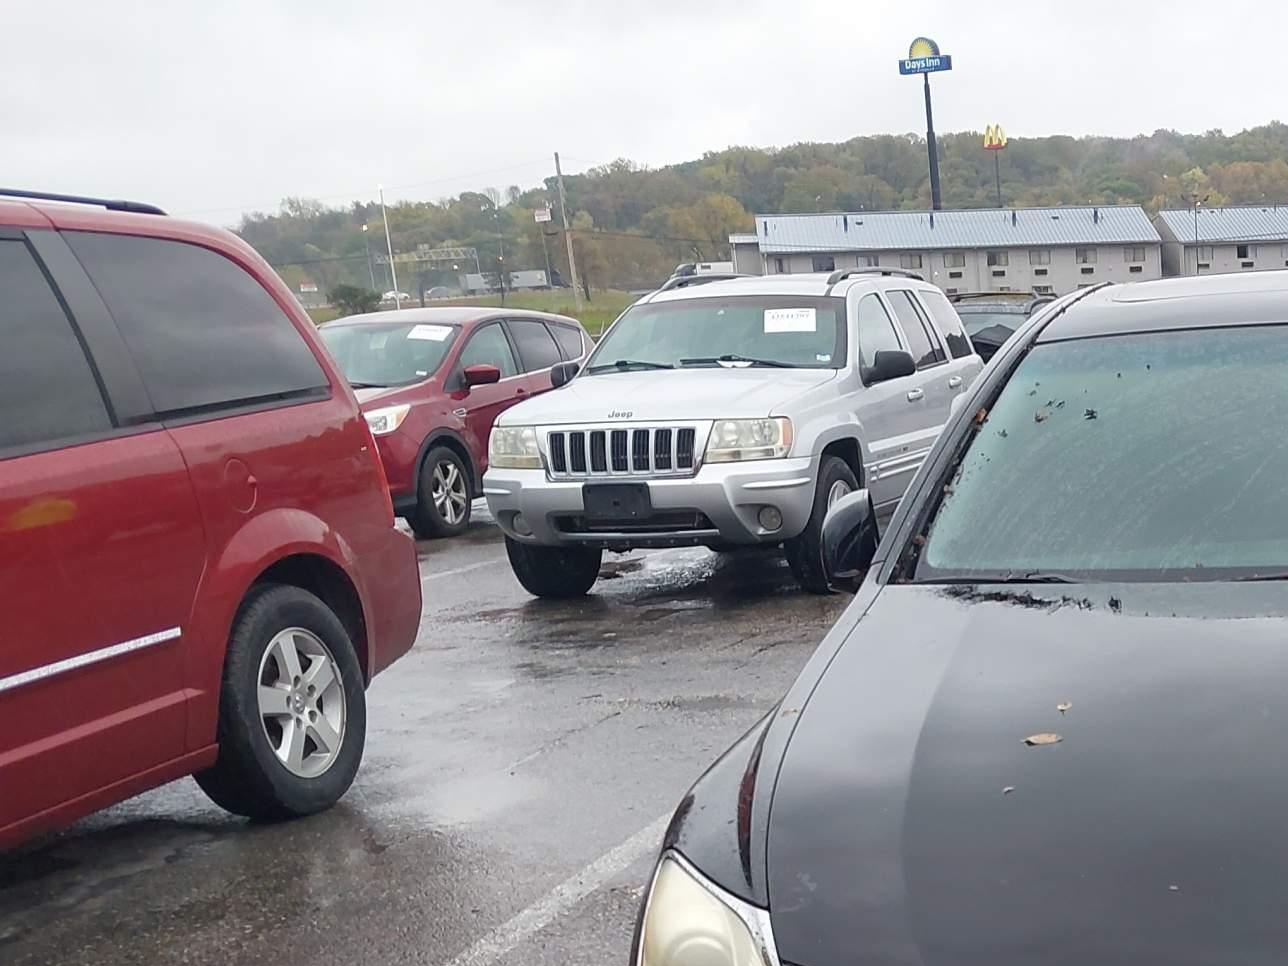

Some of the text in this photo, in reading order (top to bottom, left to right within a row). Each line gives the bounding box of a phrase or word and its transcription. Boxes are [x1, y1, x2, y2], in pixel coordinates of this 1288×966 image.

[905, 59, 926, 72] Days
[926, 57, 940, 68] Inn
[607, 409, 633, 420] Jeep
